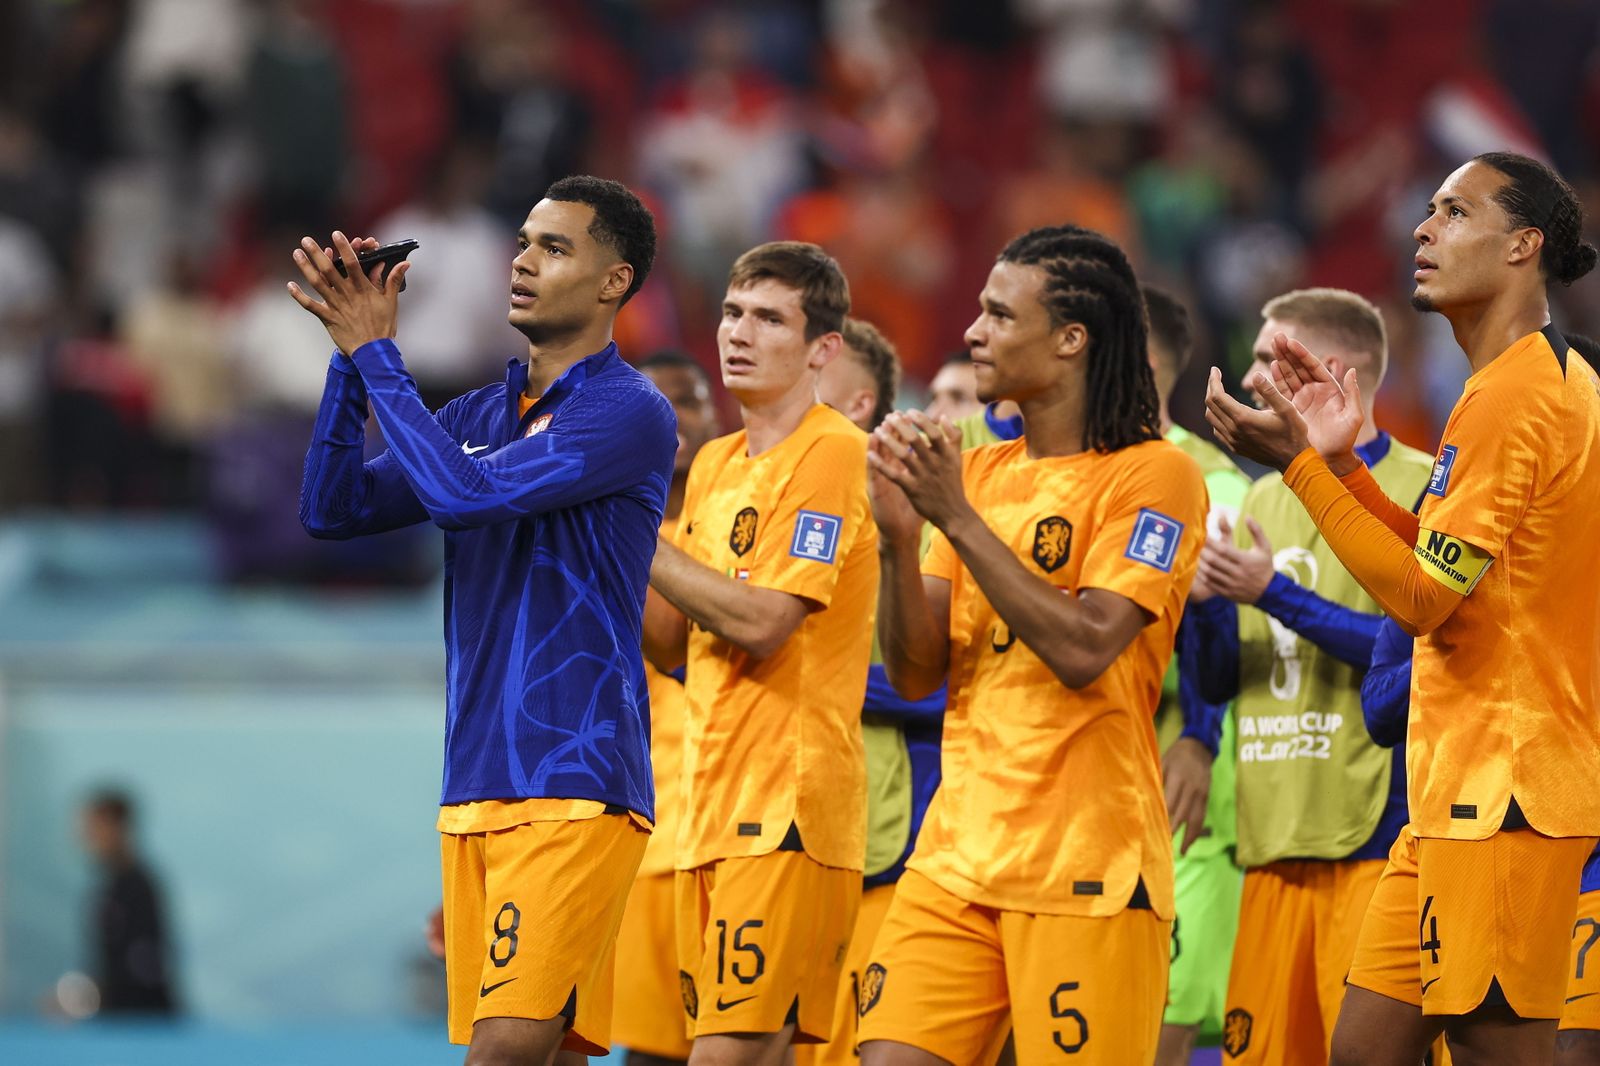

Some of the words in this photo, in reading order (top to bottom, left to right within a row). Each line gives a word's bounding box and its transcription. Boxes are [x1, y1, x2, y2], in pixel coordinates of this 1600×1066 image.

[1427, 530, 1461, 565] NO
[1300, 711, 1343, 734] CUP
[490, 902, 521, 968] 8
[716, 919, 766, 985] 15
[1420, 896, 1441, 964] 4
[1572, 917, 1600, 979] 7
[1050, 981, 1089, 1054] 5
